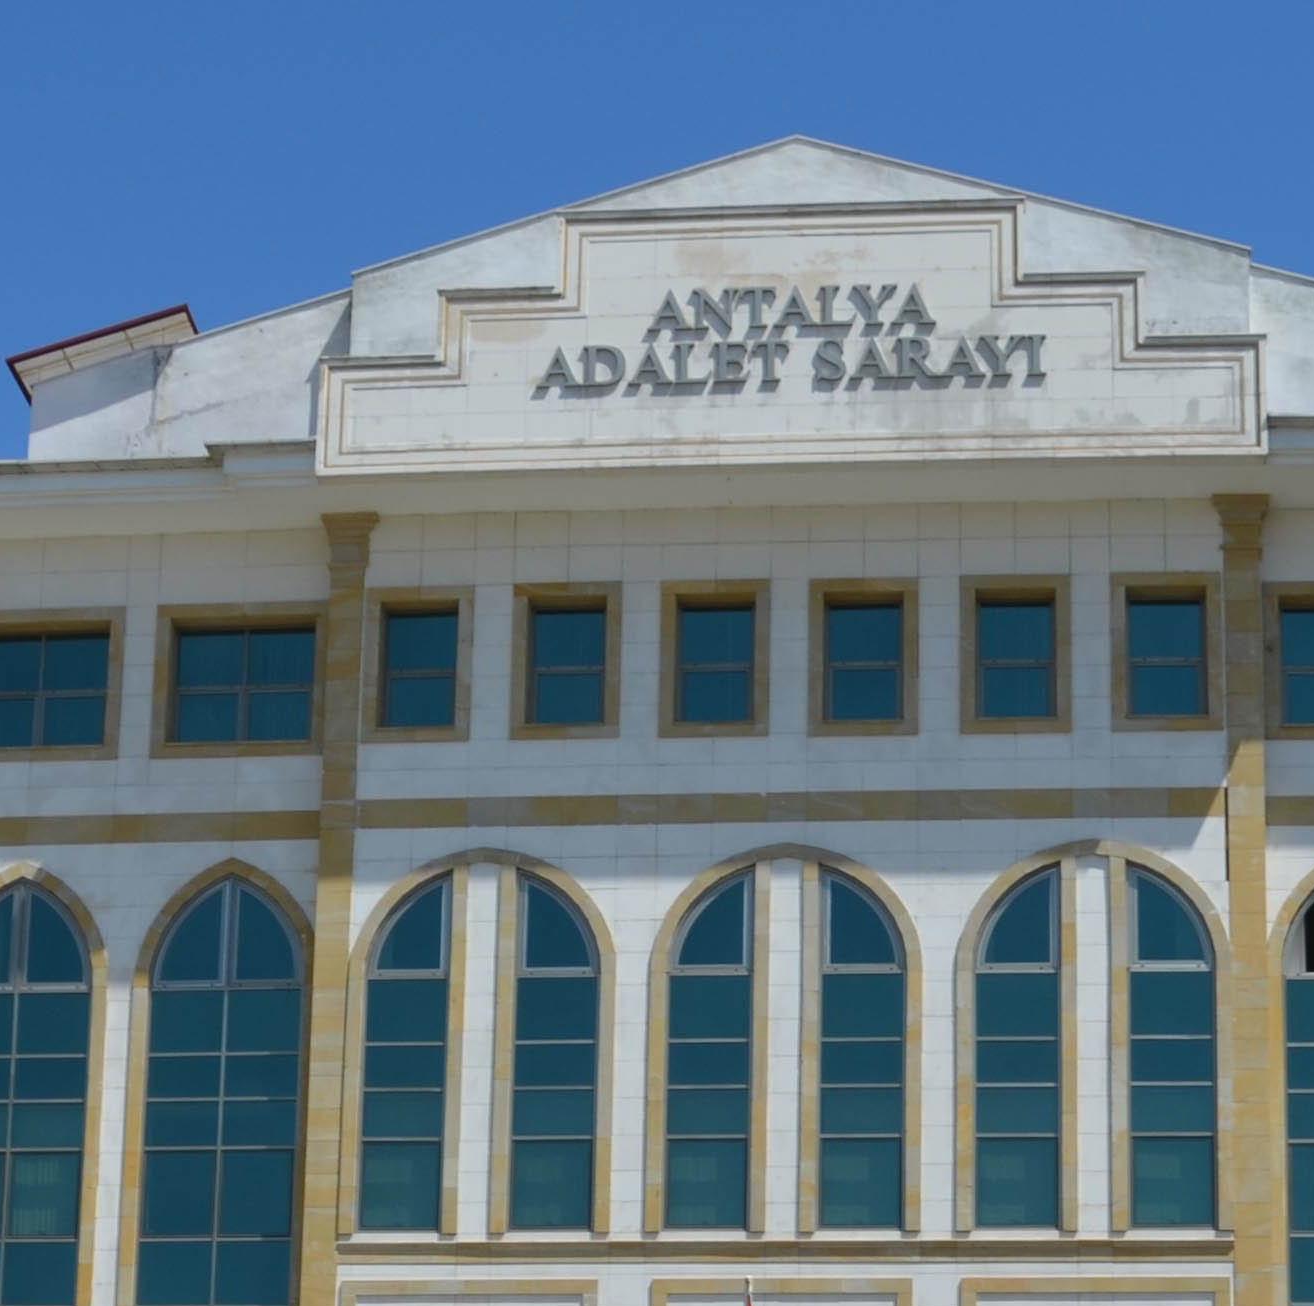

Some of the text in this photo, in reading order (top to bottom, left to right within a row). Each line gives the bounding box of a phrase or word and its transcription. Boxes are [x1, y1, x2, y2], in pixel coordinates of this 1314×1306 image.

[646, 283, 936, 335] ANTALYA
[535, 335, 1046, 391] ADALET SARAYI
